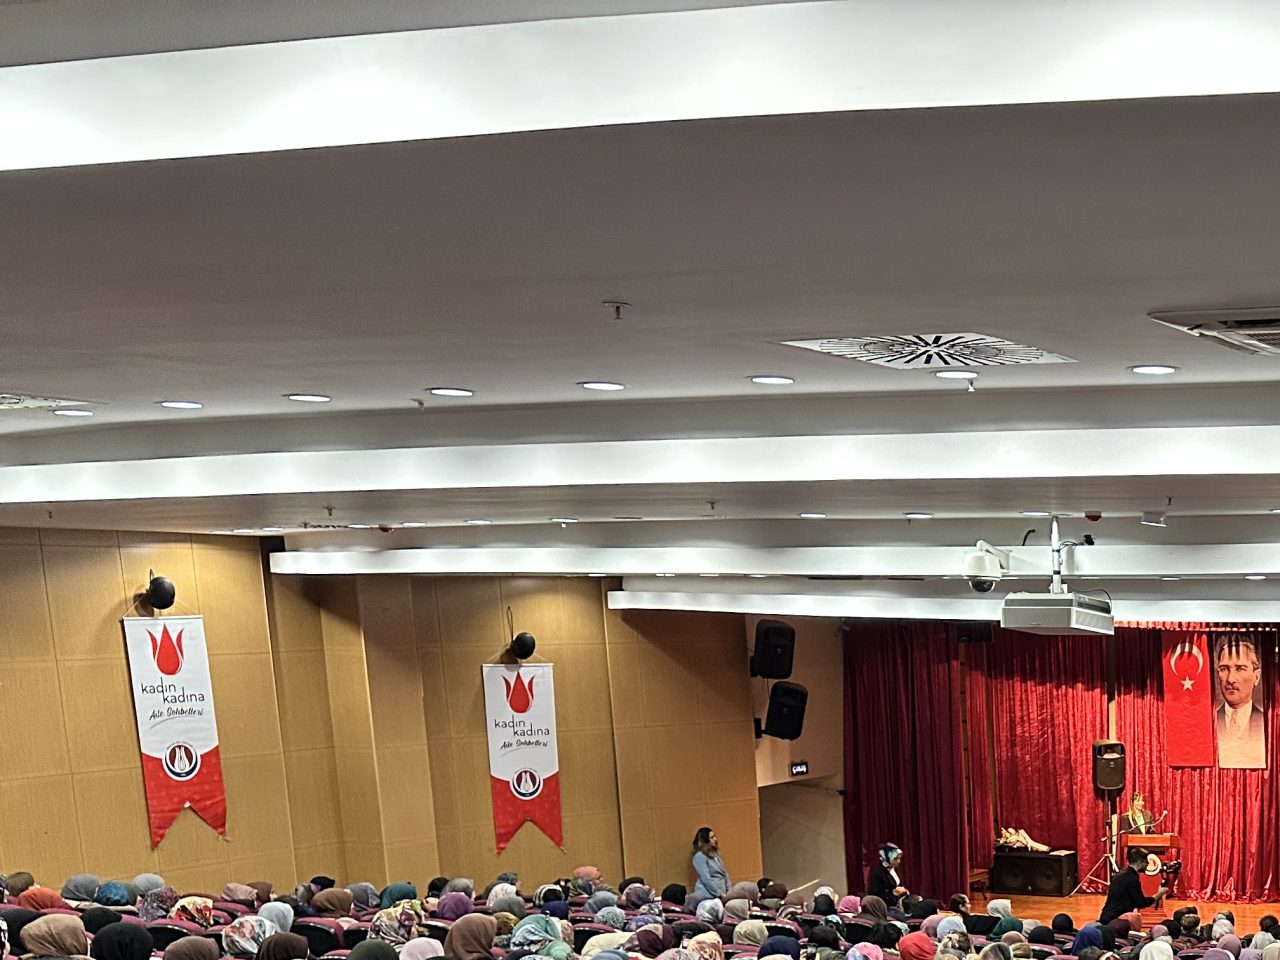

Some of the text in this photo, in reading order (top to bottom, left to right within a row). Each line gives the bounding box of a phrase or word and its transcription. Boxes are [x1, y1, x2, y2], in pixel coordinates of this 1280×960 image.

[141, 676, 177, 694] kadın
[163, 686, 205, 704] kadına
[149, 707, 204, 720] Aile Sohbetleri
[513, 722, 550, 736] kadına
